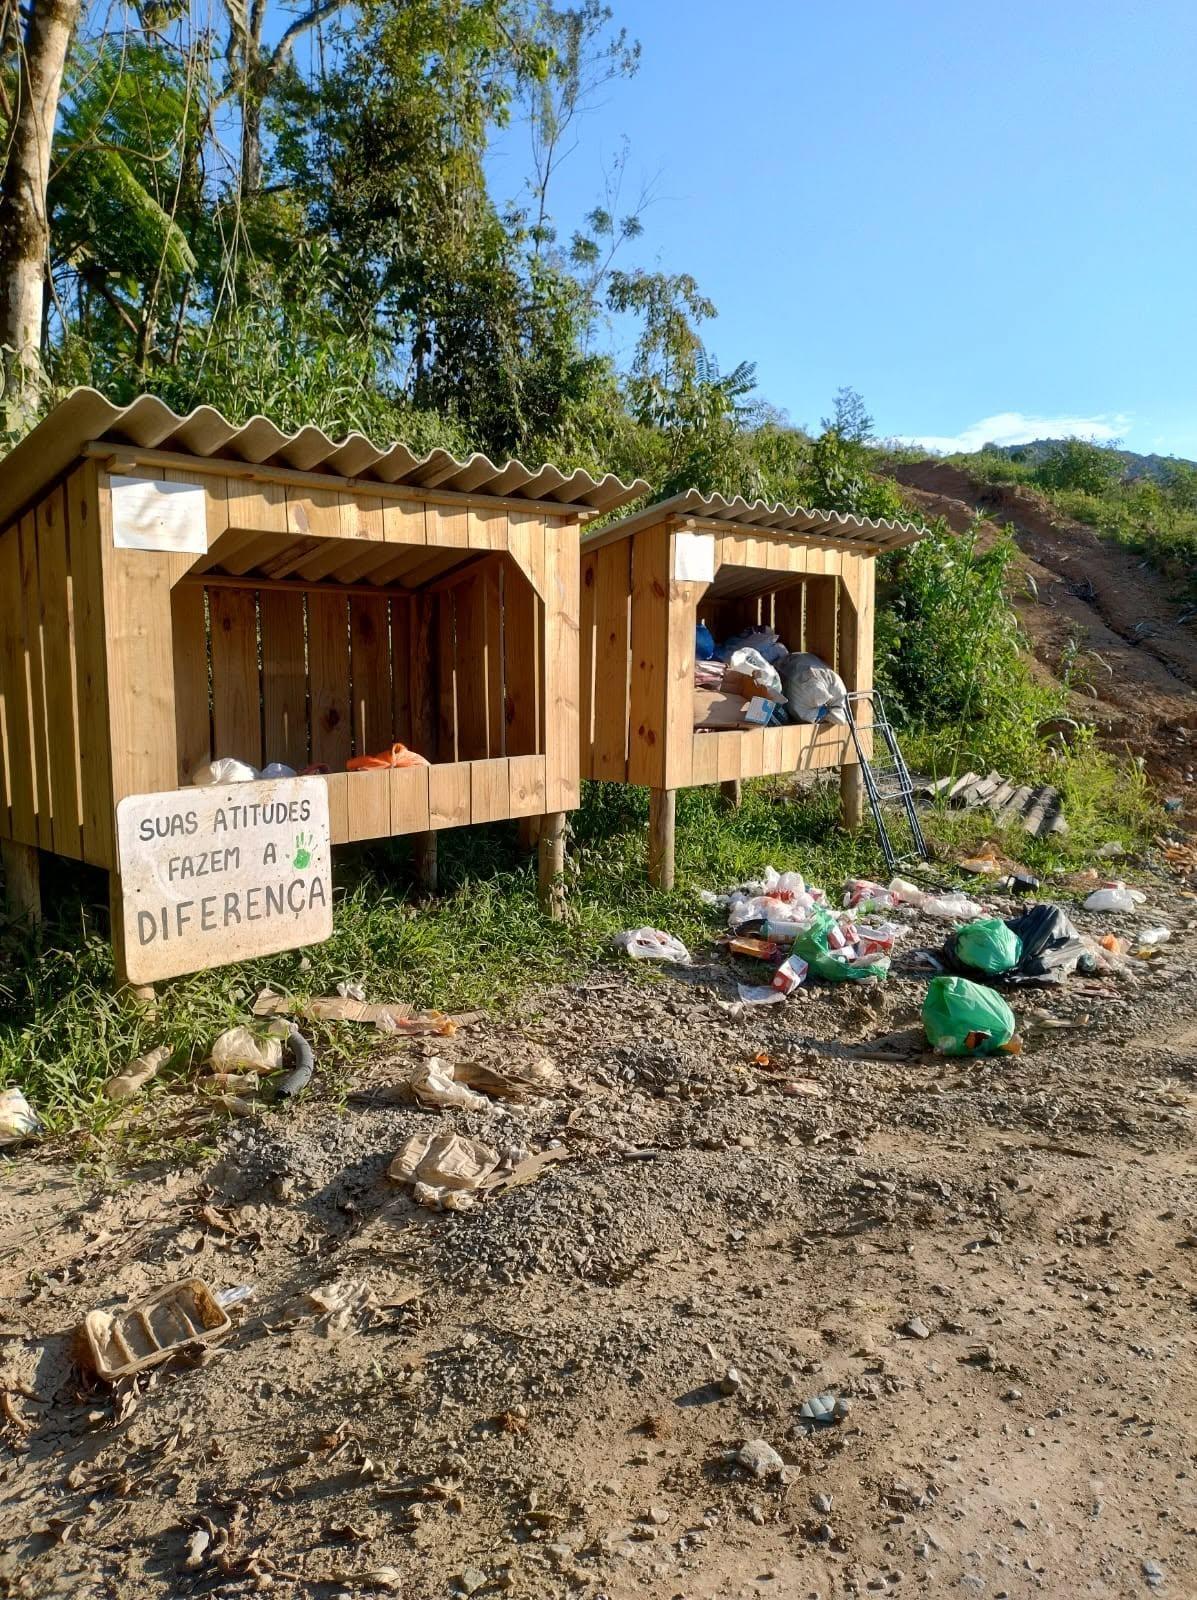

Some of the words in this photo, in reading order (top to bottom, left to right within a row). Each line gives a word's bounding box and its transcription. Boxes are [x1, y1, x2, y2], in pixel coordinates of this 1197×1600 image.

[139, 811, 198, 841] SUAS
[213, 799, 311, 832] ATITUDES
[168, 847, 240, 881] FAZEM
[263, 842, 277, 866] A
[137, 876, 326, 946] DIFERENÇA
